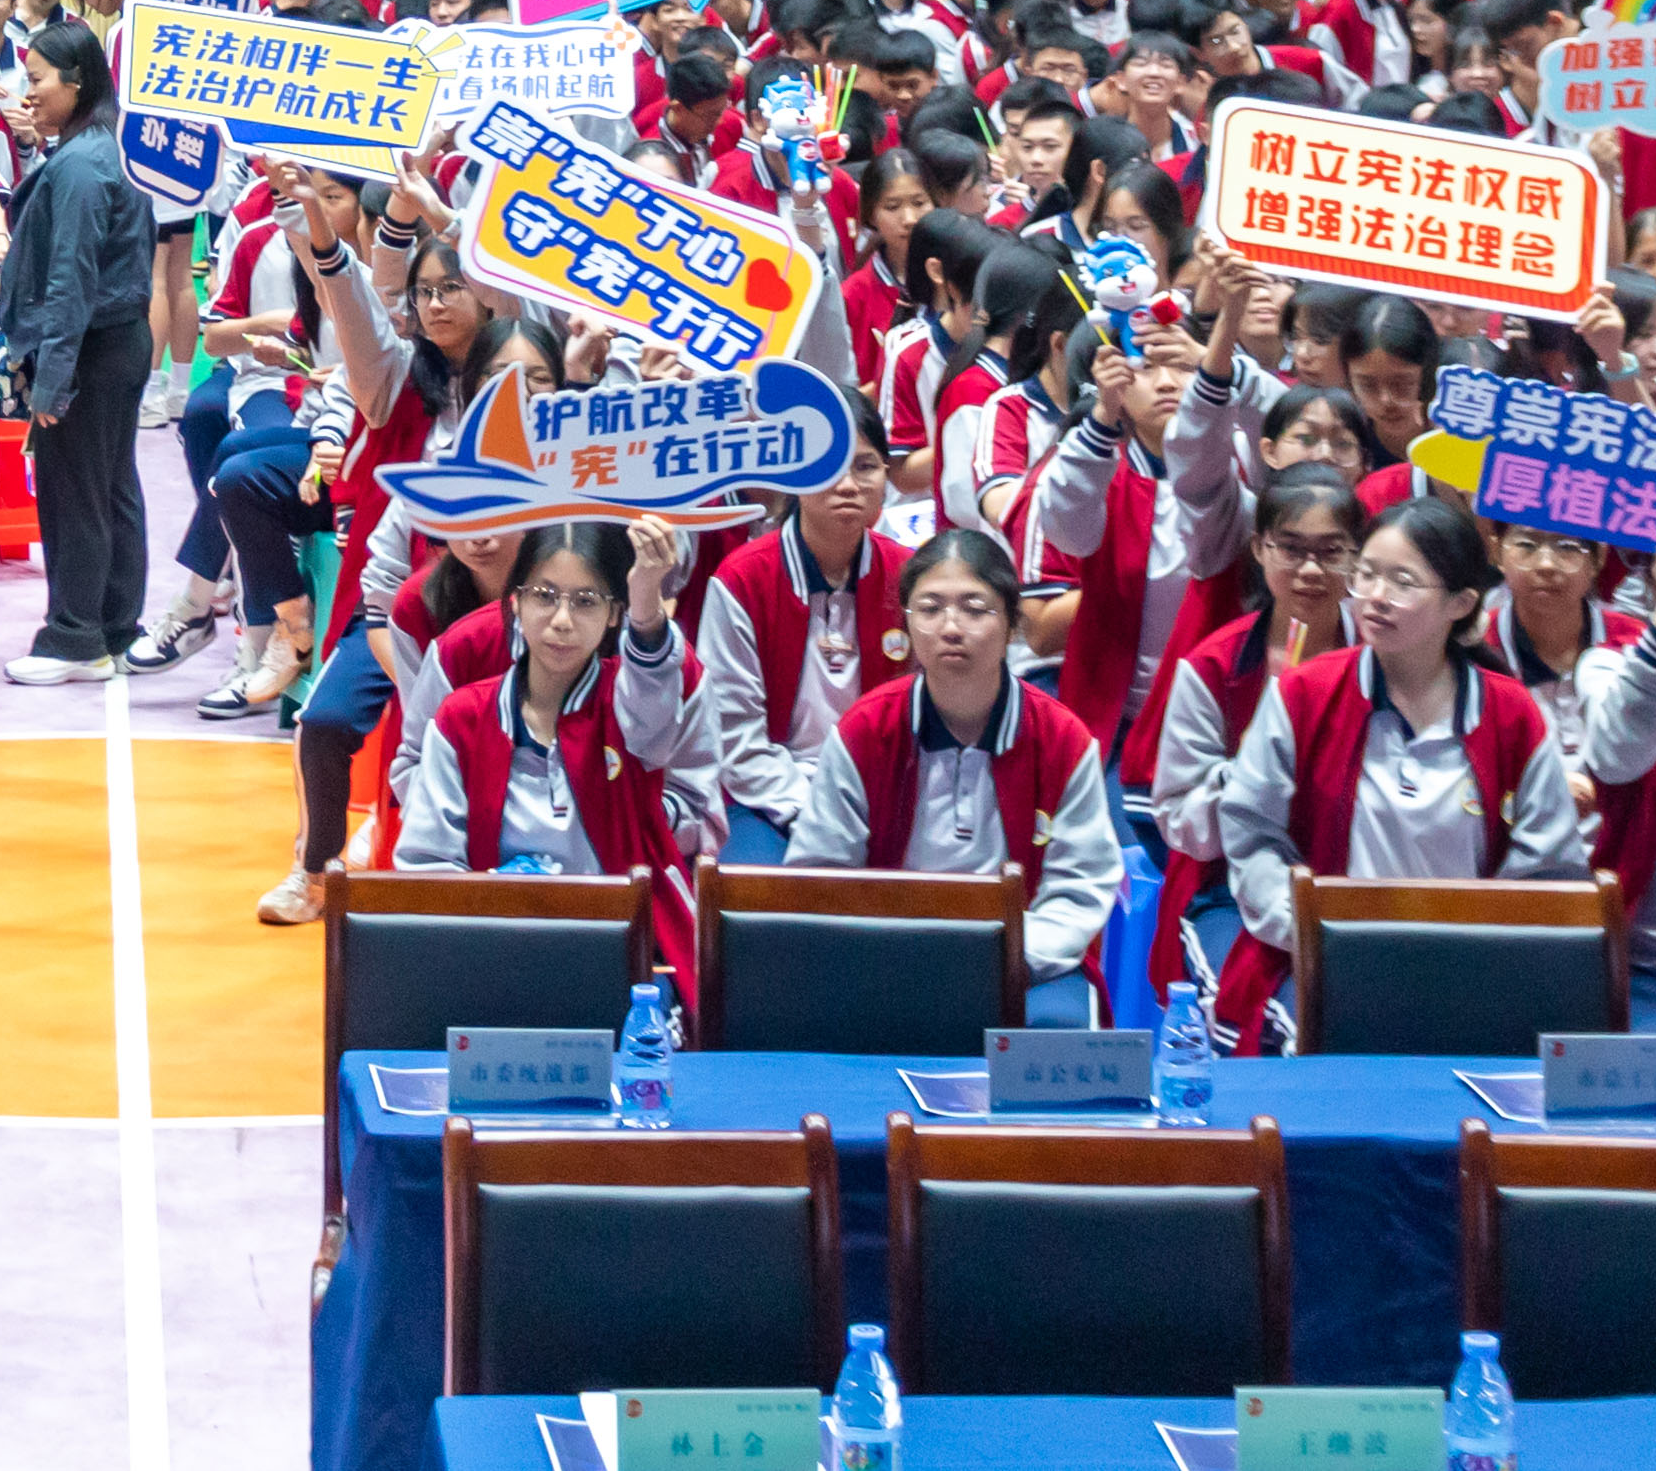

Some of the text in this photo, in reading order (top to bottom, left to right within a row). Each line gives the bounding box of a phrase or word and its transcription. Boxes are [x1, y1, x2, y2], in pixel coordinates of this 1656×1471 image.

[151, 22, 425, 93] 宪法相伴一生
[443, 73, 616, 101] 春扬帆起航
[139, 61, 409, 133] 法治护航成长
[1251, 129, 1563, 220] 树立宪法权威
[1242, 186, 1557, 278] 增强法治理念
[533, 377, 746, 442] 护航改革
